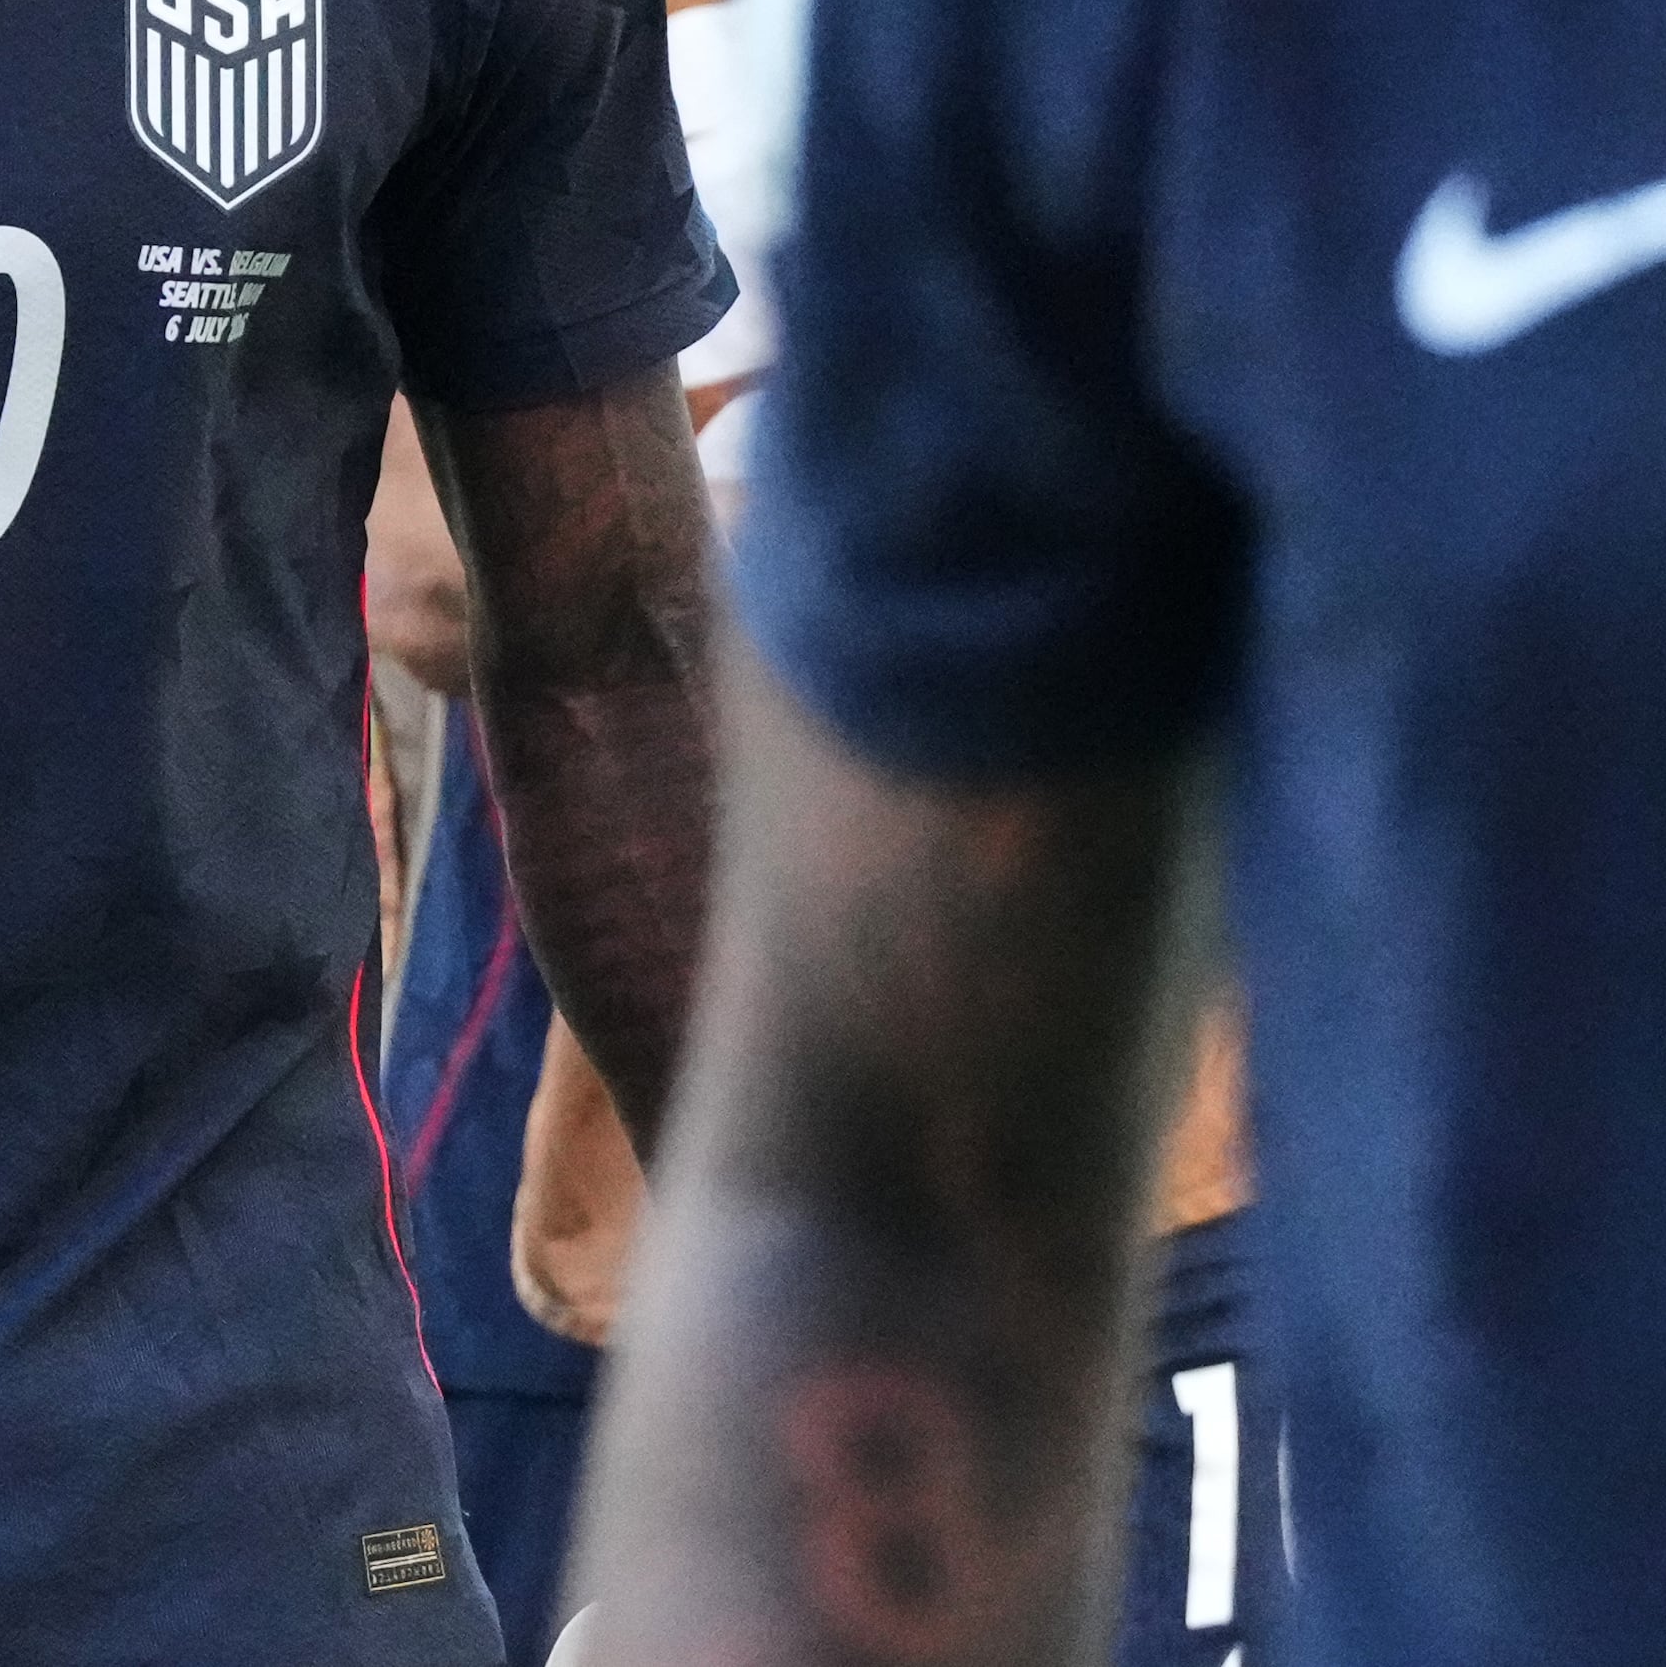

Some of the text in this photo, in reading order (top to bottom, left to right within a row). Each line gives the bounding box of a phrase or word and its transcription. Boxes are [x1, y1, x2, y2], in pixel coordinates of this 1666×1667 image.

[137, 245, 183, 273] USA
[191, 248, 223, 275] VS.
[165, 315, 182, 342] 6
[184, 316, 230, 343] JULY
